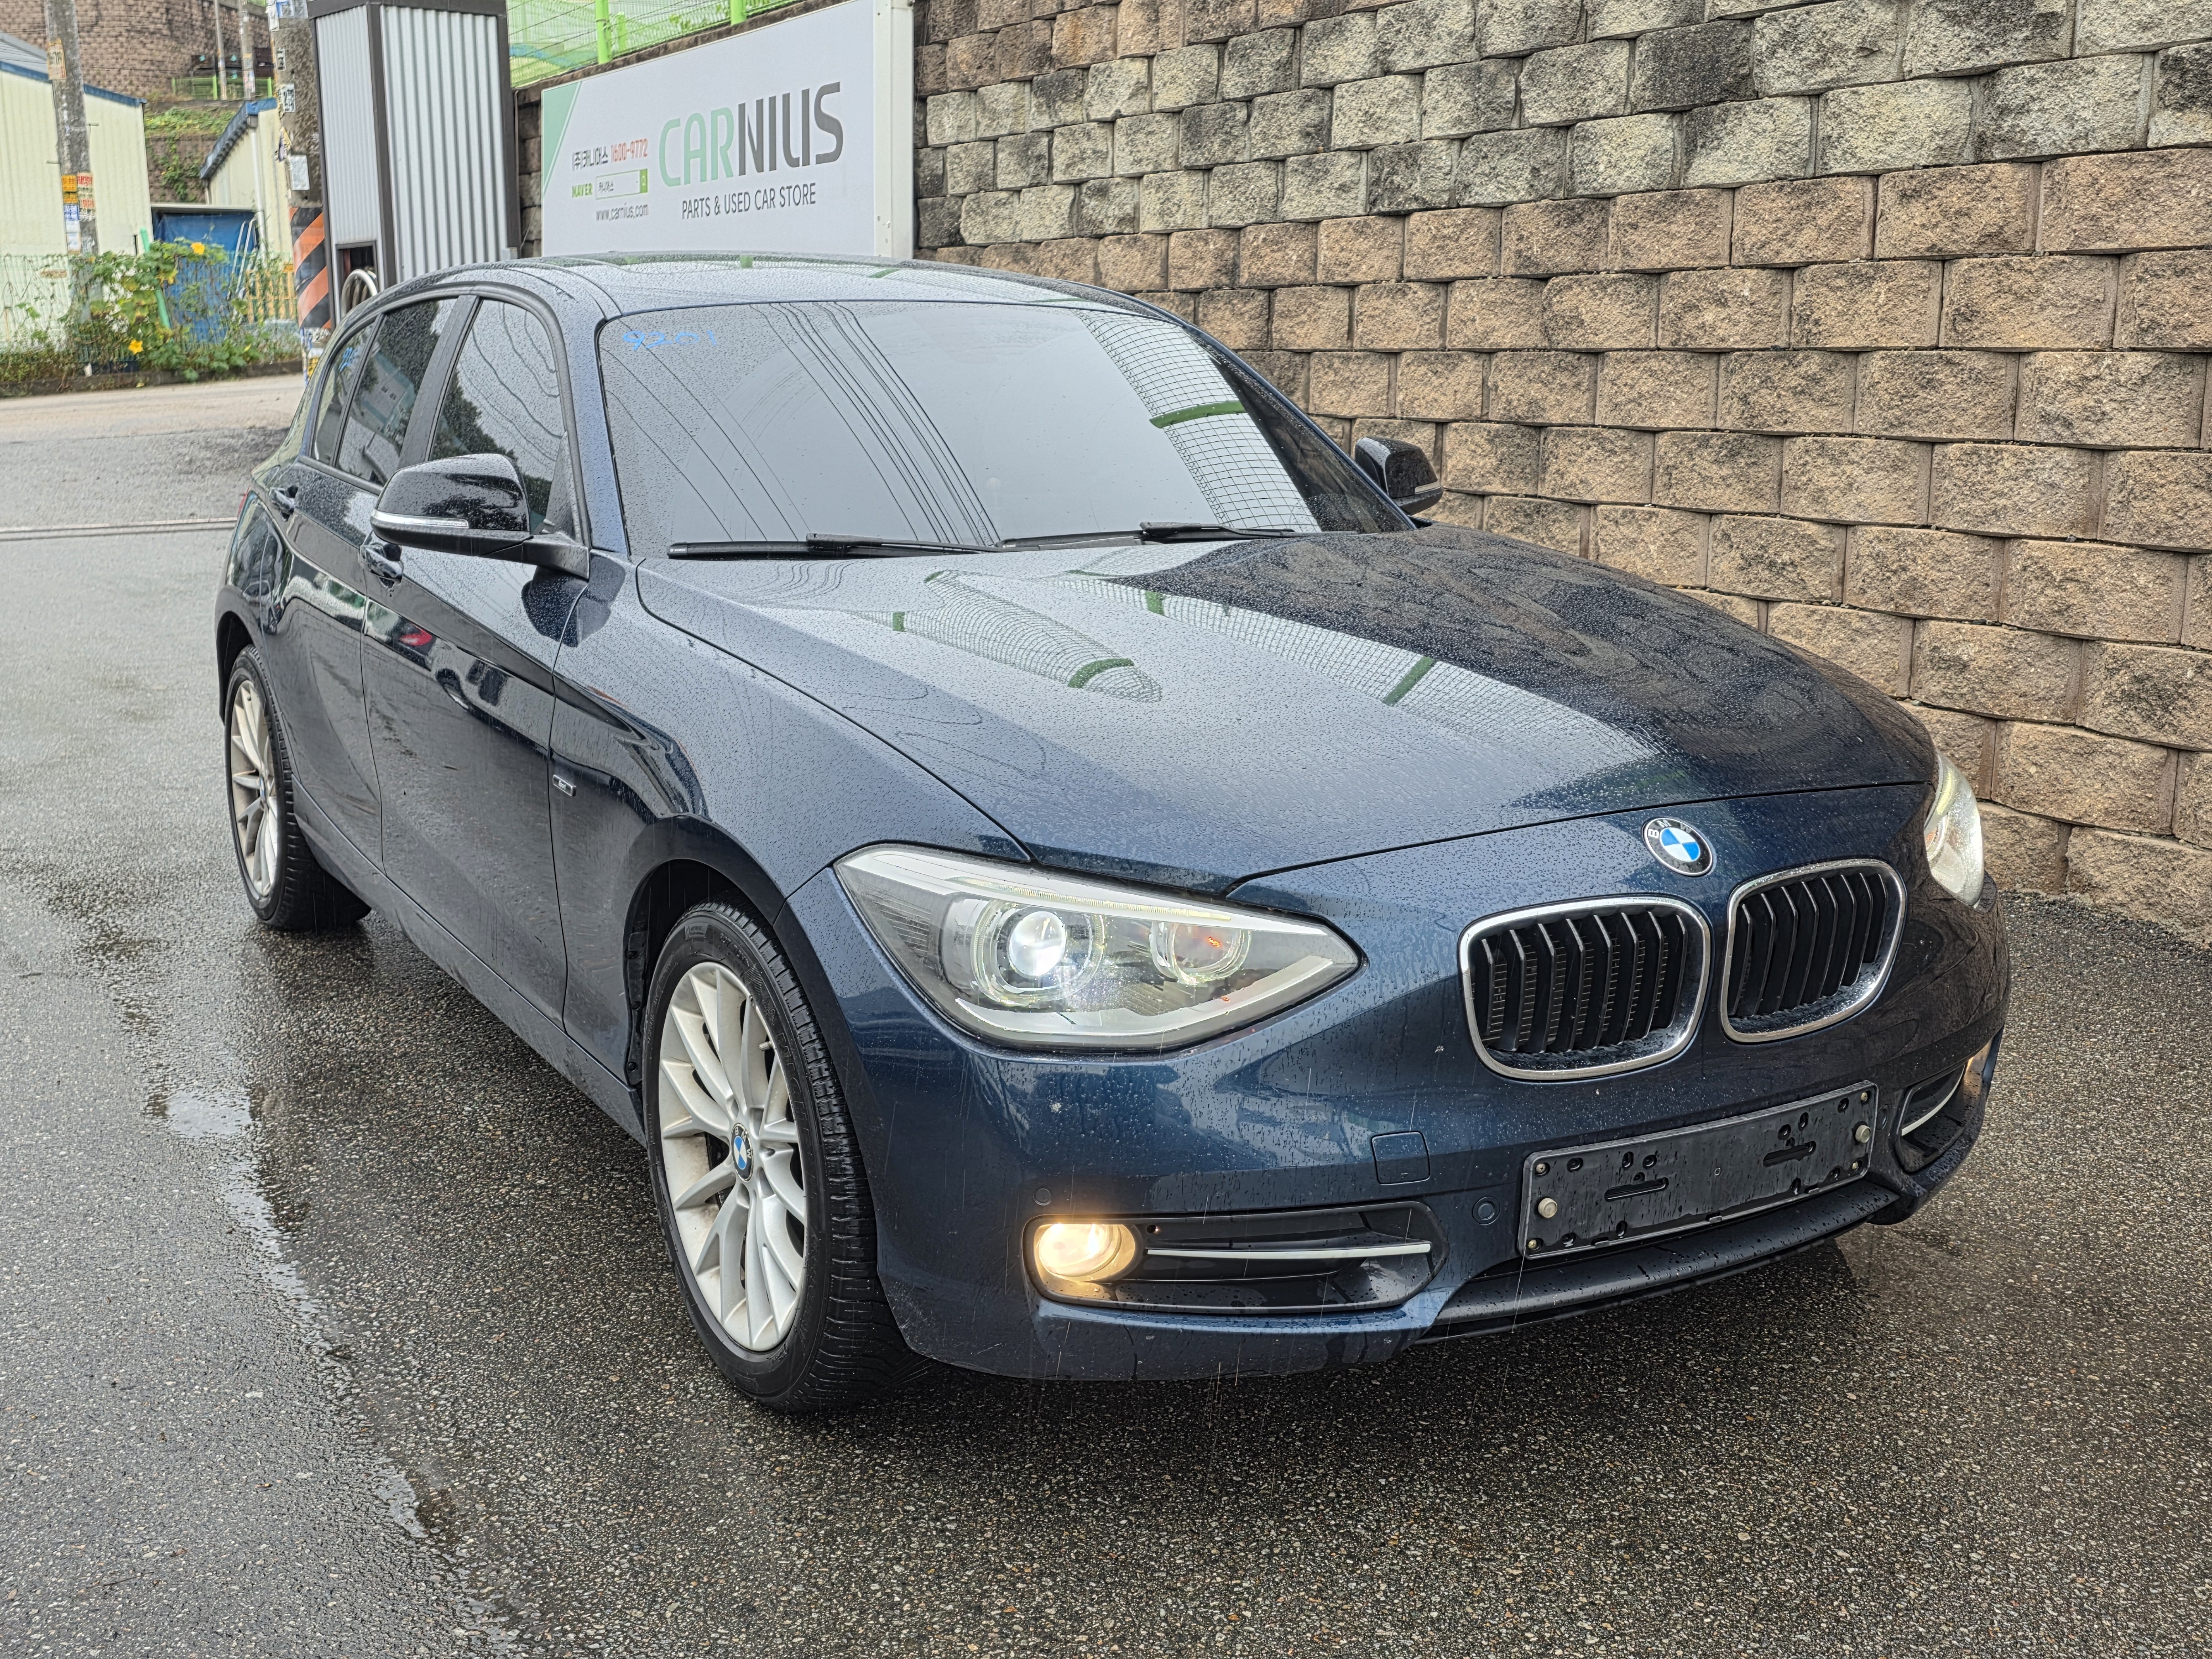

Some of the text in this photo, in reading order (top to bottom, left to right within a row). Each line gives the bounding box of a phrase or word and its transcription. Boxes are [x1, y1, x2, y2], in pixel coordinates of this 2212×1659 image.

[659, 81, 843, 187] CARNIUS
[572, 183, 593, 197] NAVER
[682, 182, 816, 220] PARTS & USED CAR STORE
[1647, 818, 1693, 839] BMW
[734, 1126, 752, 1159] BMW
